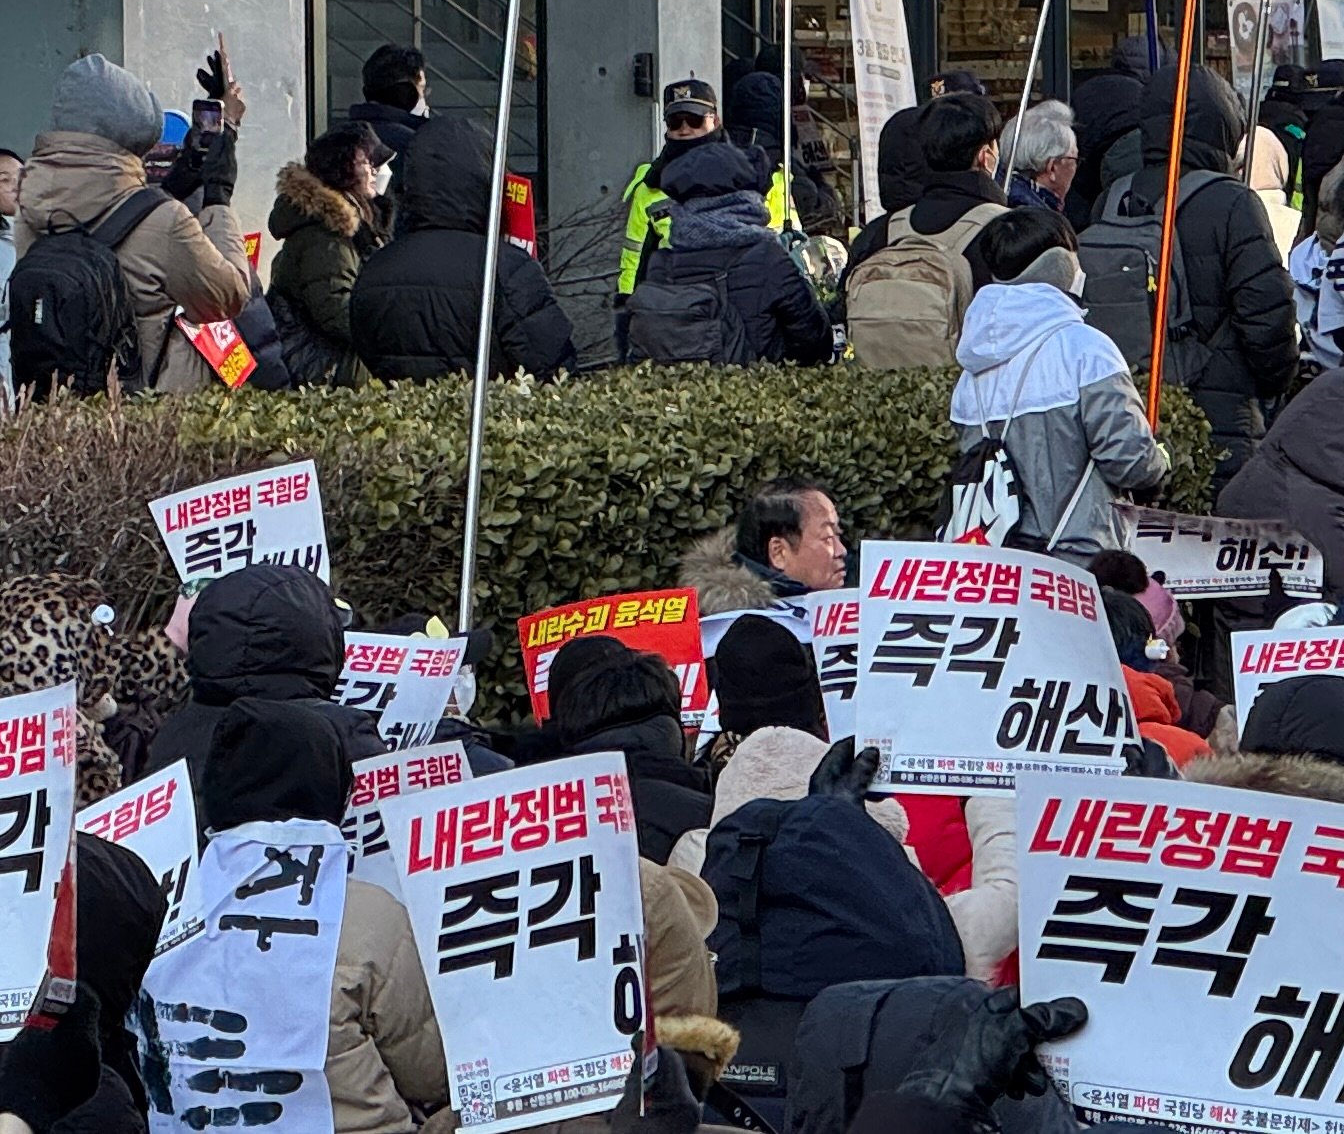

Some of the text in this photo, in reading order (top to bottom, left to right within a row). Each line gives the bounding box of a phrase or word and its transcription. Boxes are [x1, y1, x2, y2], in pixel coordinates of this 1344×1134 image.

[165, 472, 311, 534] 내란정범 국힘당
[185, 519, 258, 574] 즉각
[1216, 538, 1309, 571] 해산!
[868, 559, 1098, 623] 내란정범 국힘당
[528, 596, 688, 648] 내란수괴 윤석열
[868, 612, 1021, 690] 즉각
[345, 643, 461, 677] 정범 국힘당
[407, 753, 462, 788] 국힘당
[407, 780, 588, 876] 내란정범
[1028, 798, 1292, 880] 내란정범
[437, 855, 601, 980] 즉각
[1036, 875, 1276, 998] 즉각
[503, 1069, 545, 1092] <윤석열
[547, 1064, 571, 1083] 파면
[574, 1059, 608, 1077] 국힘당
[1082, 1089, 1130, 1109] <윤석열
[1133, 1095, 1160, 1113] 파면
[1164, 1101, 1205, 1120] 국힘당
[1209, 1106, 1236, 1124] 해산
[1242, 1109, 1319, 1133] 촛불문화제>
